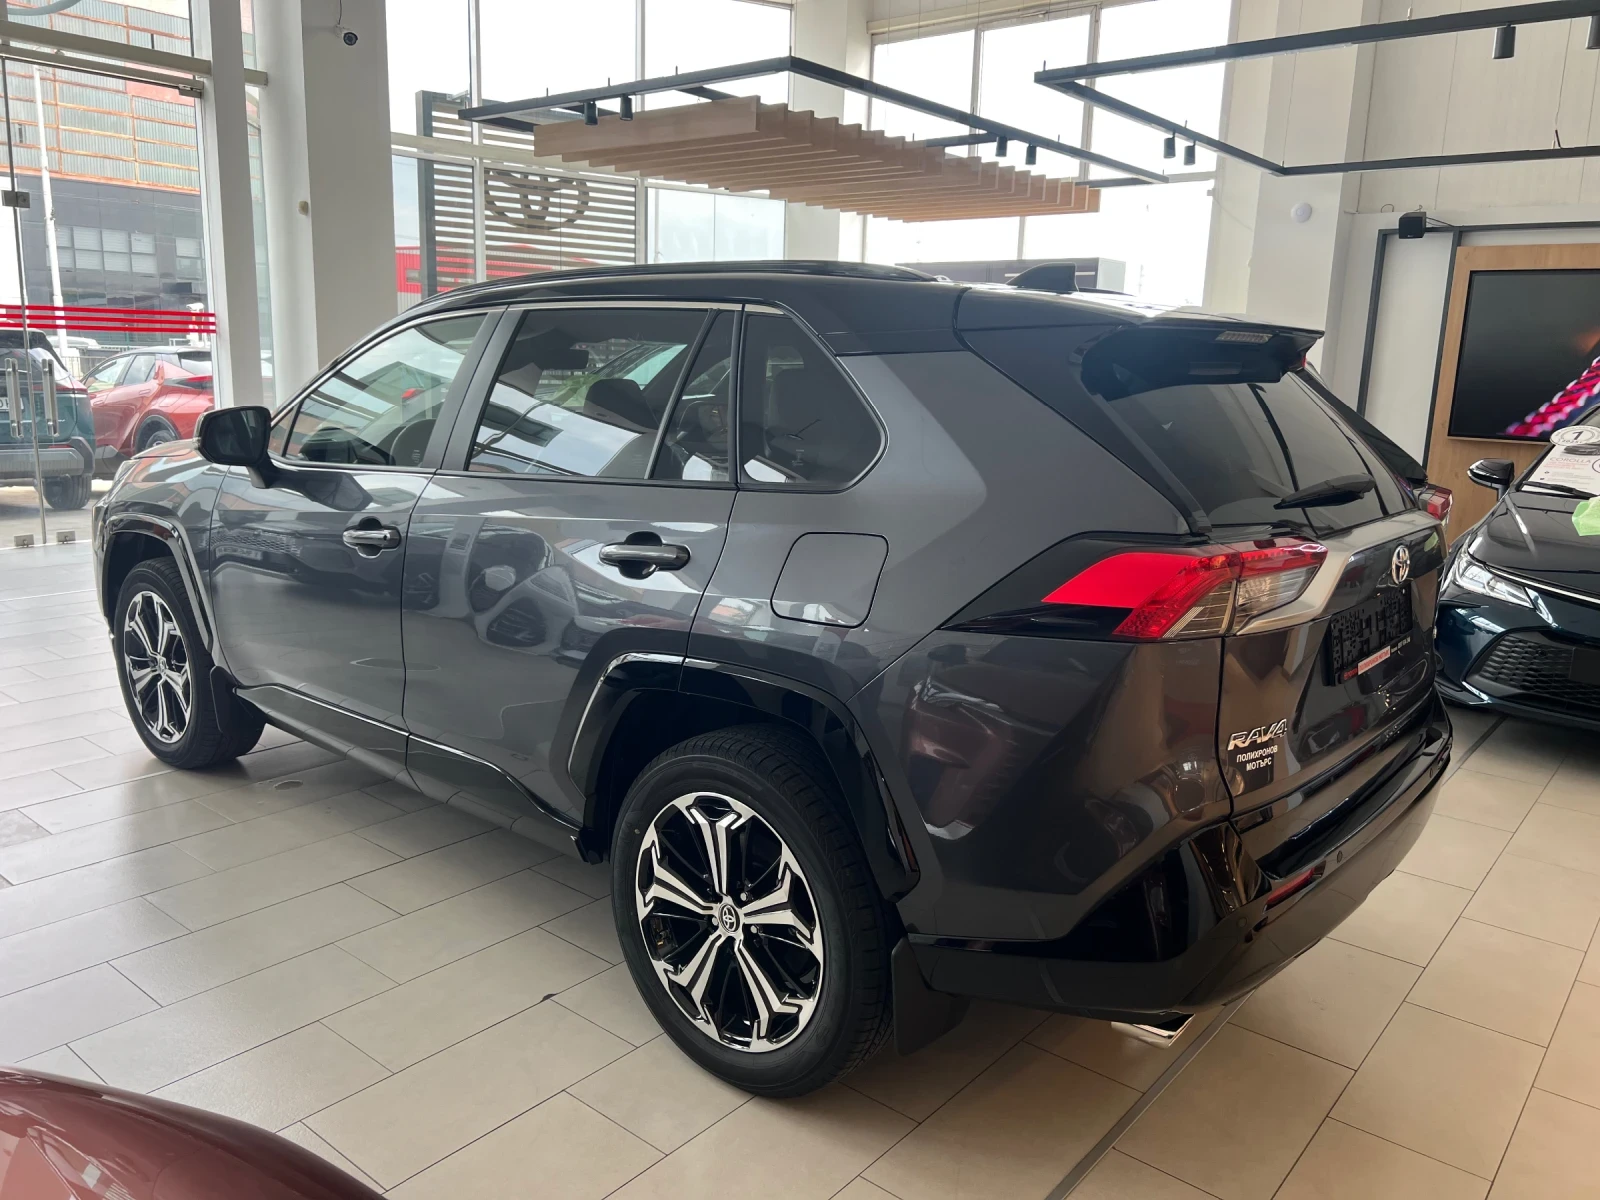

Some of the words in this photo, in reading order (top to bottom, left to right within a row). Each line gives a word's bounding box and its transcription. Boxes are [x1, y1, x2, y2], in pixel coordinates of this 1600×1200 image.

[1572, 430, 1584, 440] 1
[1227, 718, 1288, 751] RAV4
[1236, 745, 1278, 763] ПОЛИХРОНОВ
[1246, 757, 1272, 771] МОТЪРС
